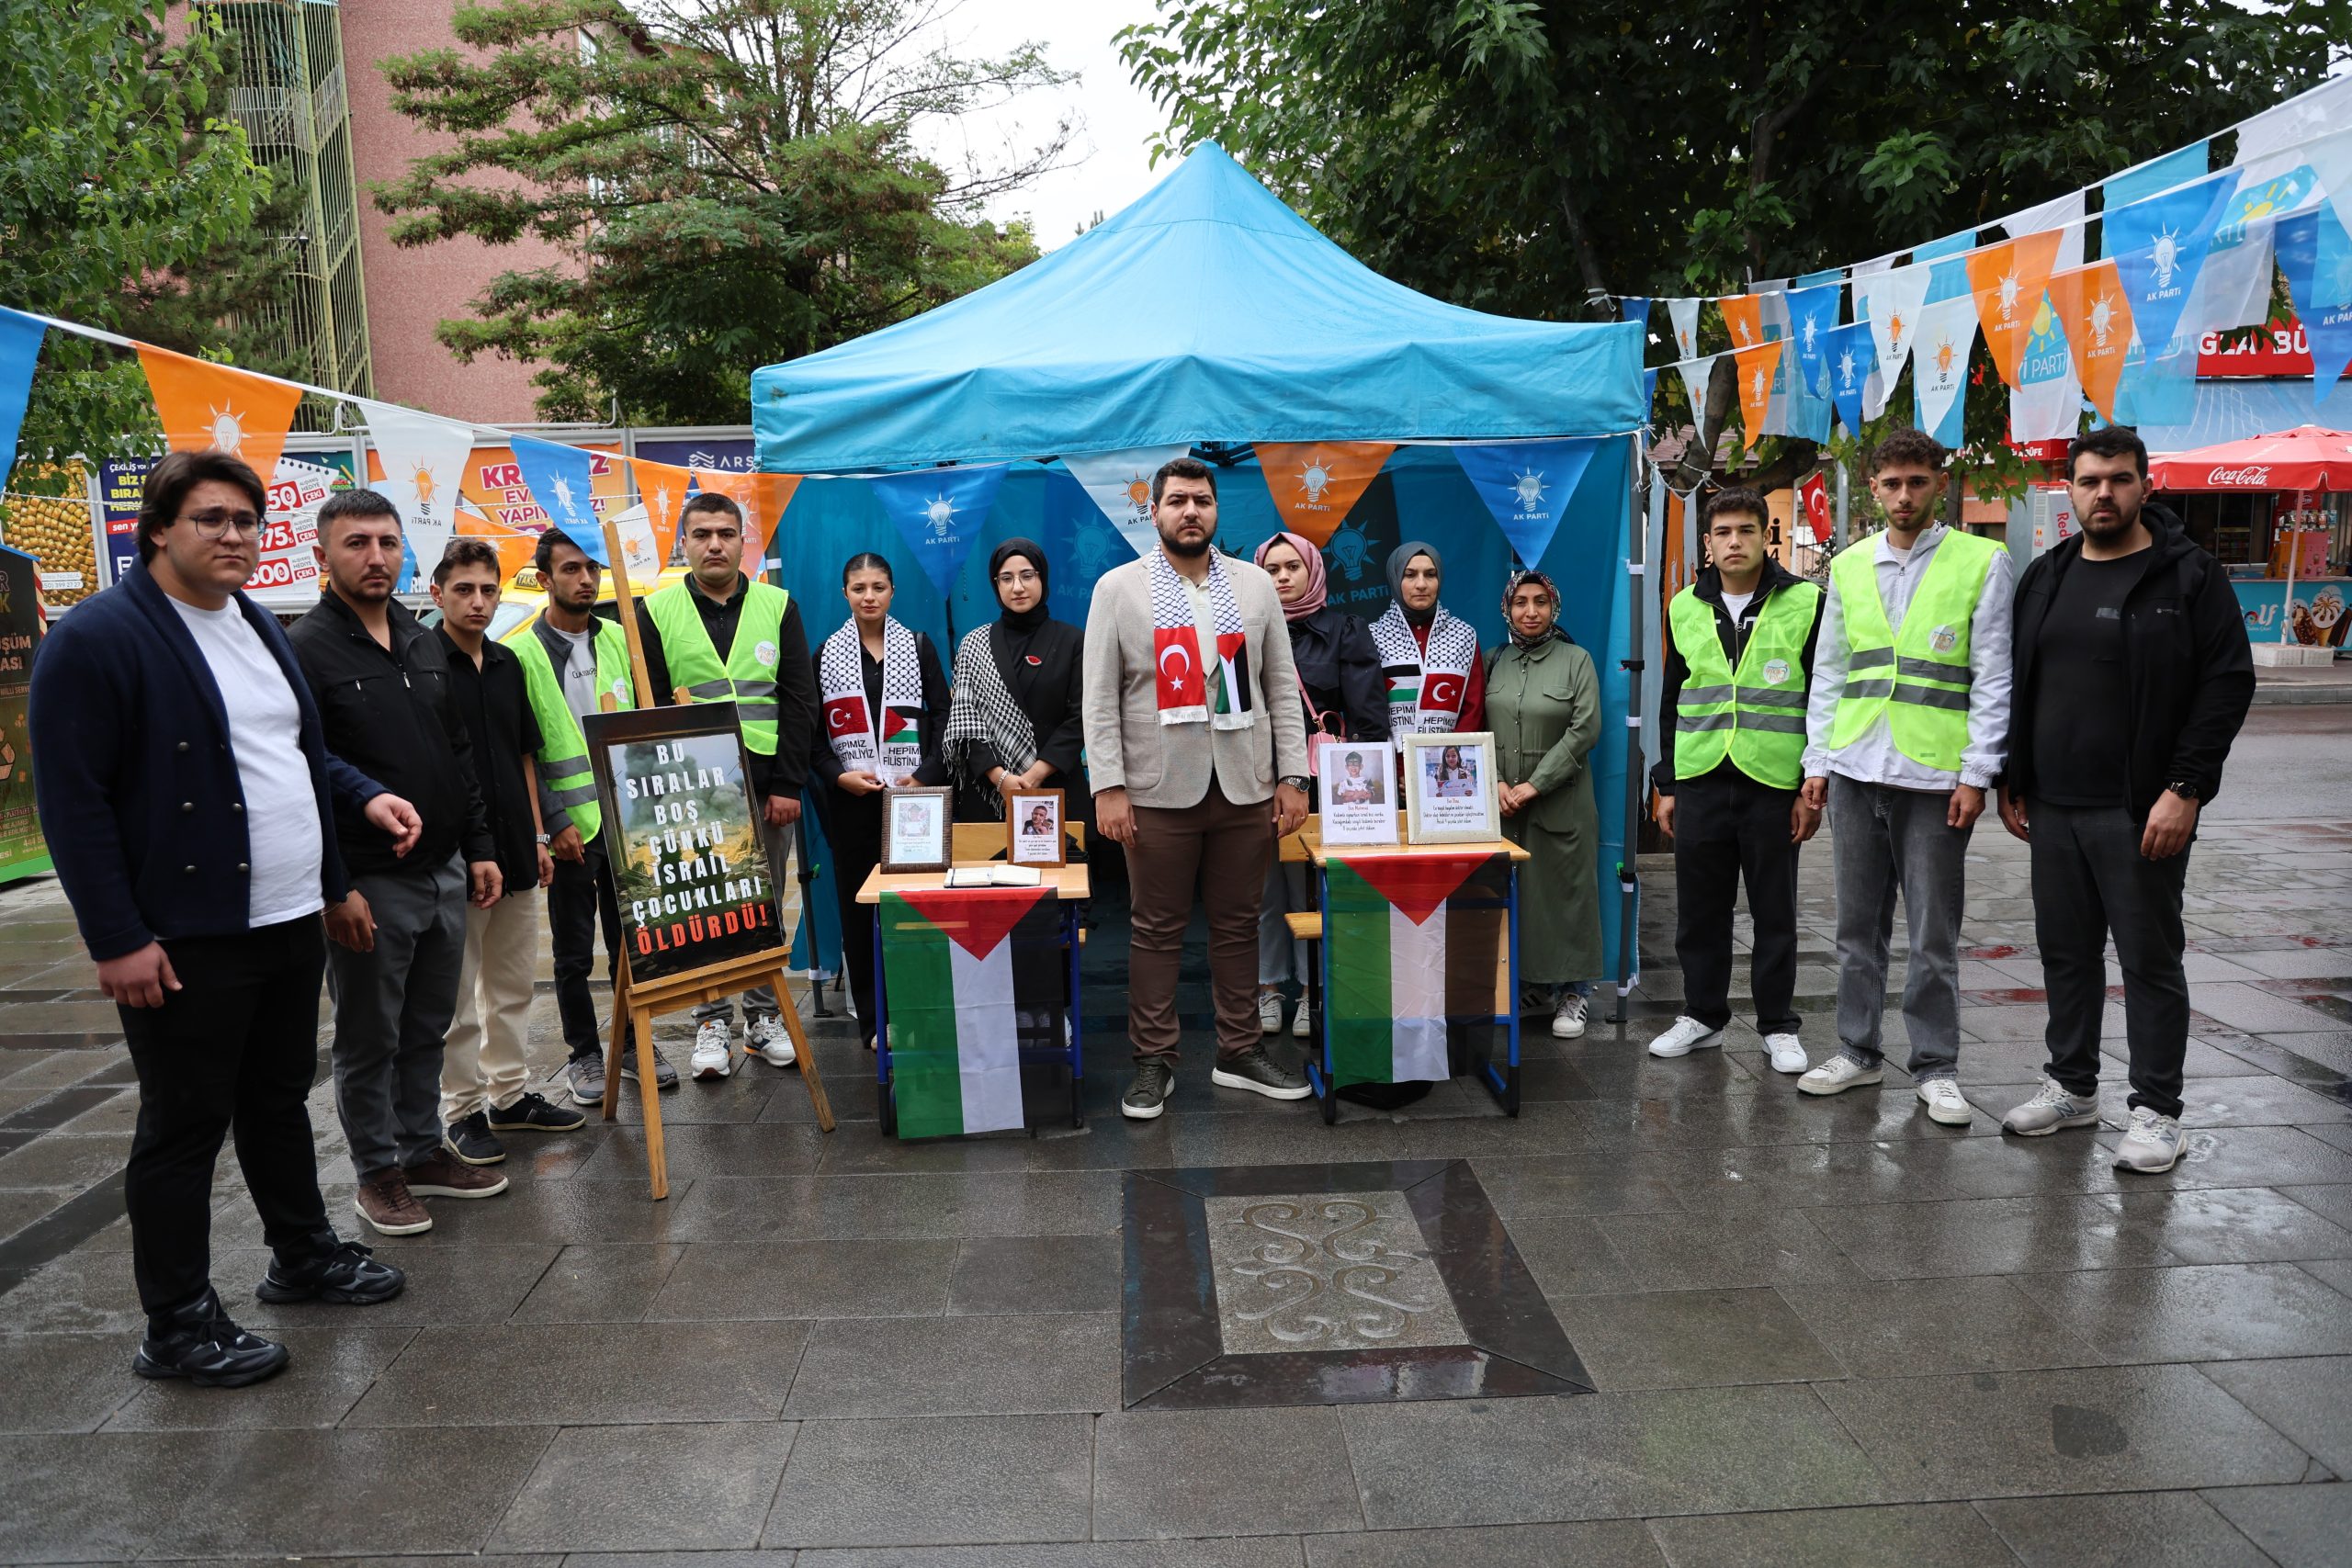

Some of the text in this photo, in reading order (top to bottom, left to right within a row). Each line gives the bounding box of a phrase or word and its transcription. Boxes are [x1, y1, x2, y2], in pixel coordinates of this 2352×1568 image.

[2146, 292, 2156, 301] AK
[2323, 315, 2335, 326] AK
[720, 456, 753, 468] ARS
[119, 473, 139, 485] BİZ
[2207, 466, 2272, 486] Coca-Cola
[111, 489, 144, 499] BIRA
[505, 489, 529, 503] EV
[112, 523, 129, 531] sen
[1328, 592, 1346, 605] AK
[656, 742, 684, 765] BU
[888, 746, 920, 755] HEPİM
[625, 766, 726, 800] SIRALAR
[654, 799, 699, 827] BOŞ
[649, 821, 725, 863] ÇÜNKÜ
[652, 852, 732, 886] İSRAİL
[632, 875, 763, 928] ÇOCUKLARI
[635, 900, 769, 956] ÖLDÜRDÜ!
